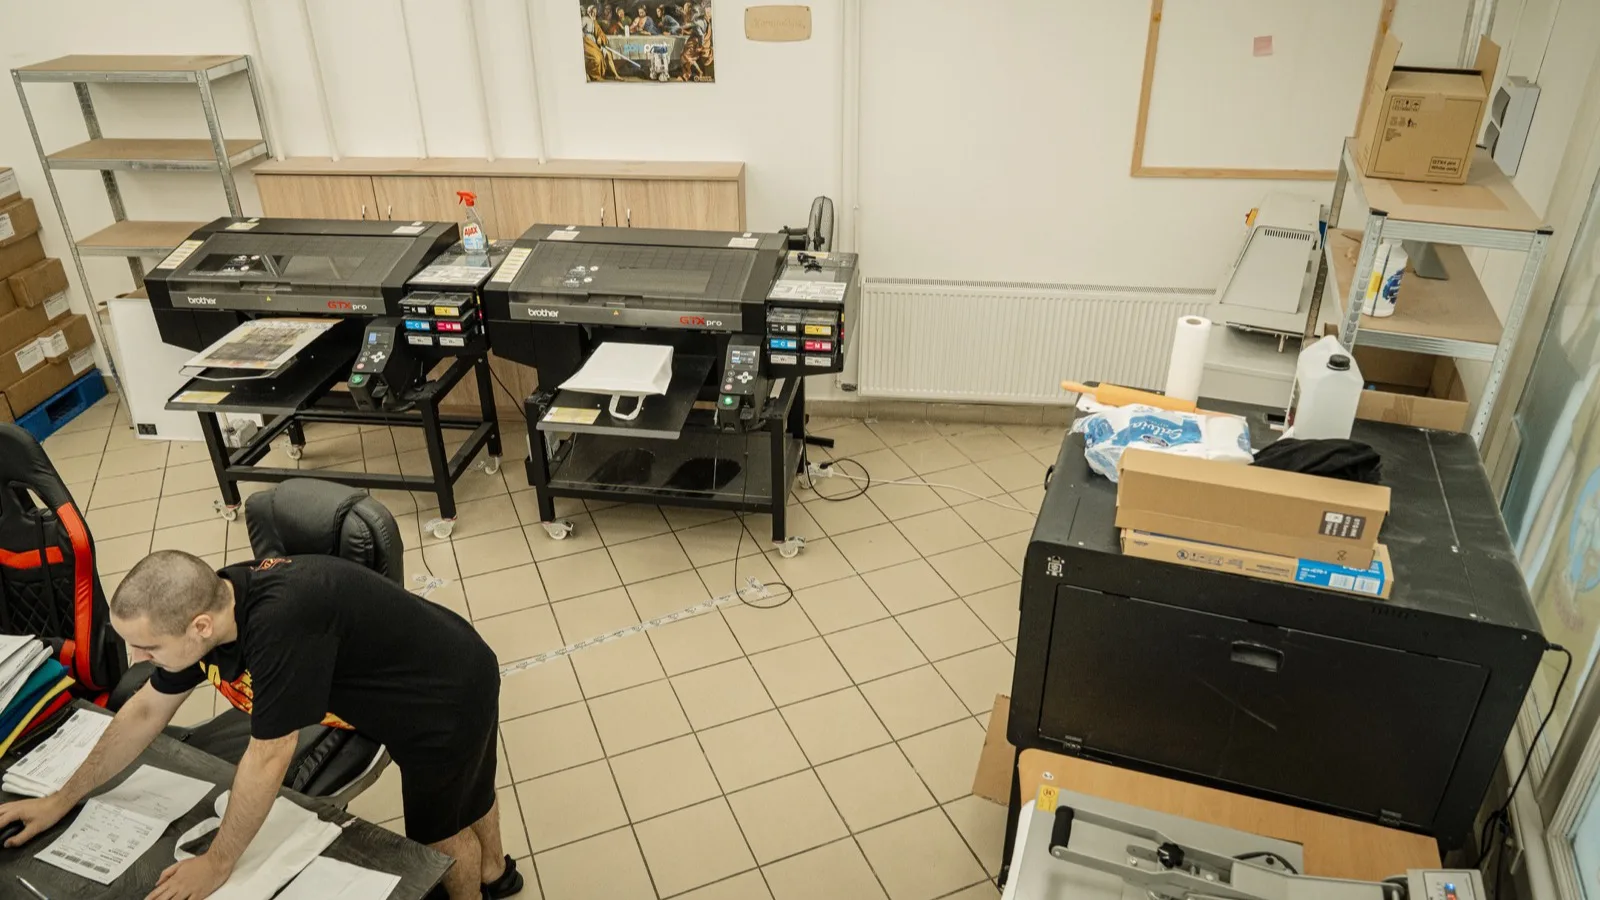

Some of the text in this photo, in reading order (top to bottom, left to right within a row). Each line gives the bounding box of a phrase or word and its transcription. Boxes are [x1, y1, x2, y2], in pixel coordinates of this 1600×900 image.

[464, 226, 478, 237] AJAX
[187, 296, 217, 305] brother
[327, 300, 351, 309] GTX
[527, 307, 559, 318] brother
[679, 315, 723, 327] GTX pro
[1130, 422, 1183, 440] Silvia
